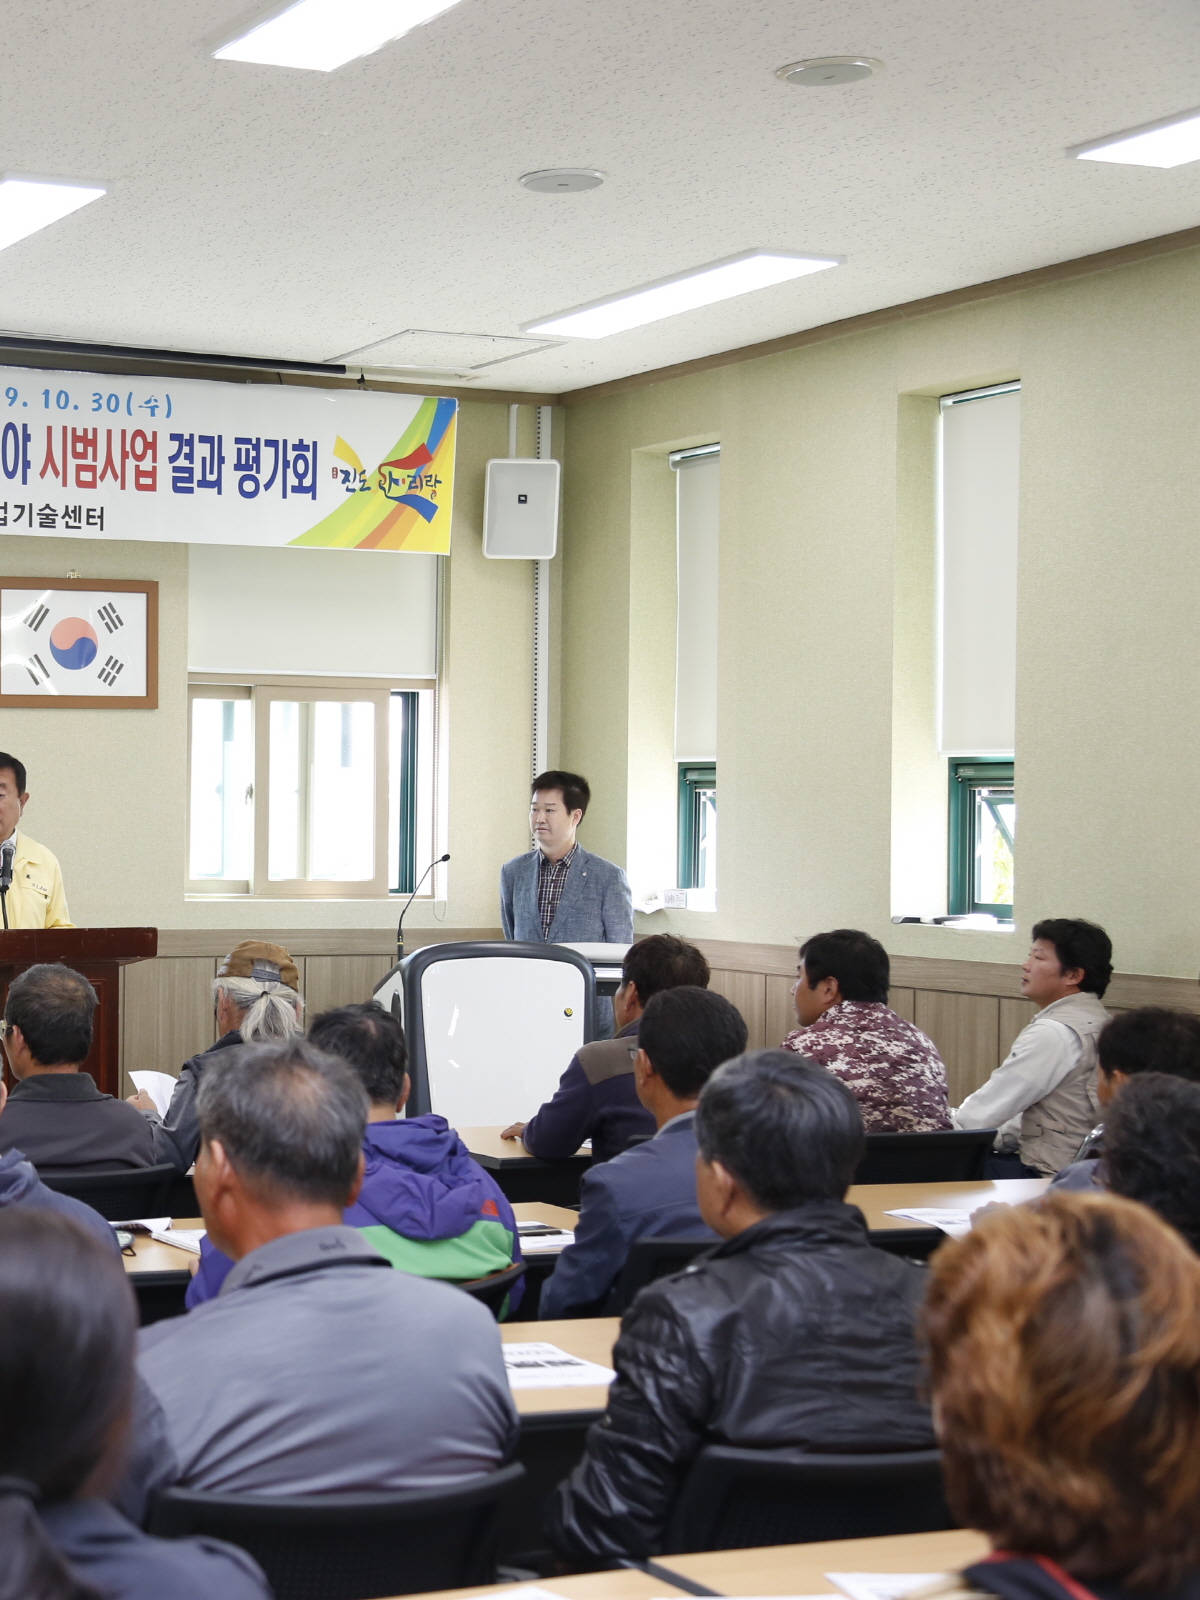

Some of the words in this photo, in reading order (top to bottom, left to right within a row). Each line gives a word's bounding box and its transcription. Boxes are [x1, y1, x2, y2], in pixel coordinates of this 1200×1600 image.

[41, 388, 79, 411] 10.
[91, 391, 172, 419] 30(수)
[39, 425, 158, 492] 시범사업
[167, 433, 225, 495] 결과
[233, 436, 318, 501] 평가회
[339, 467, 372, 493] 진도
